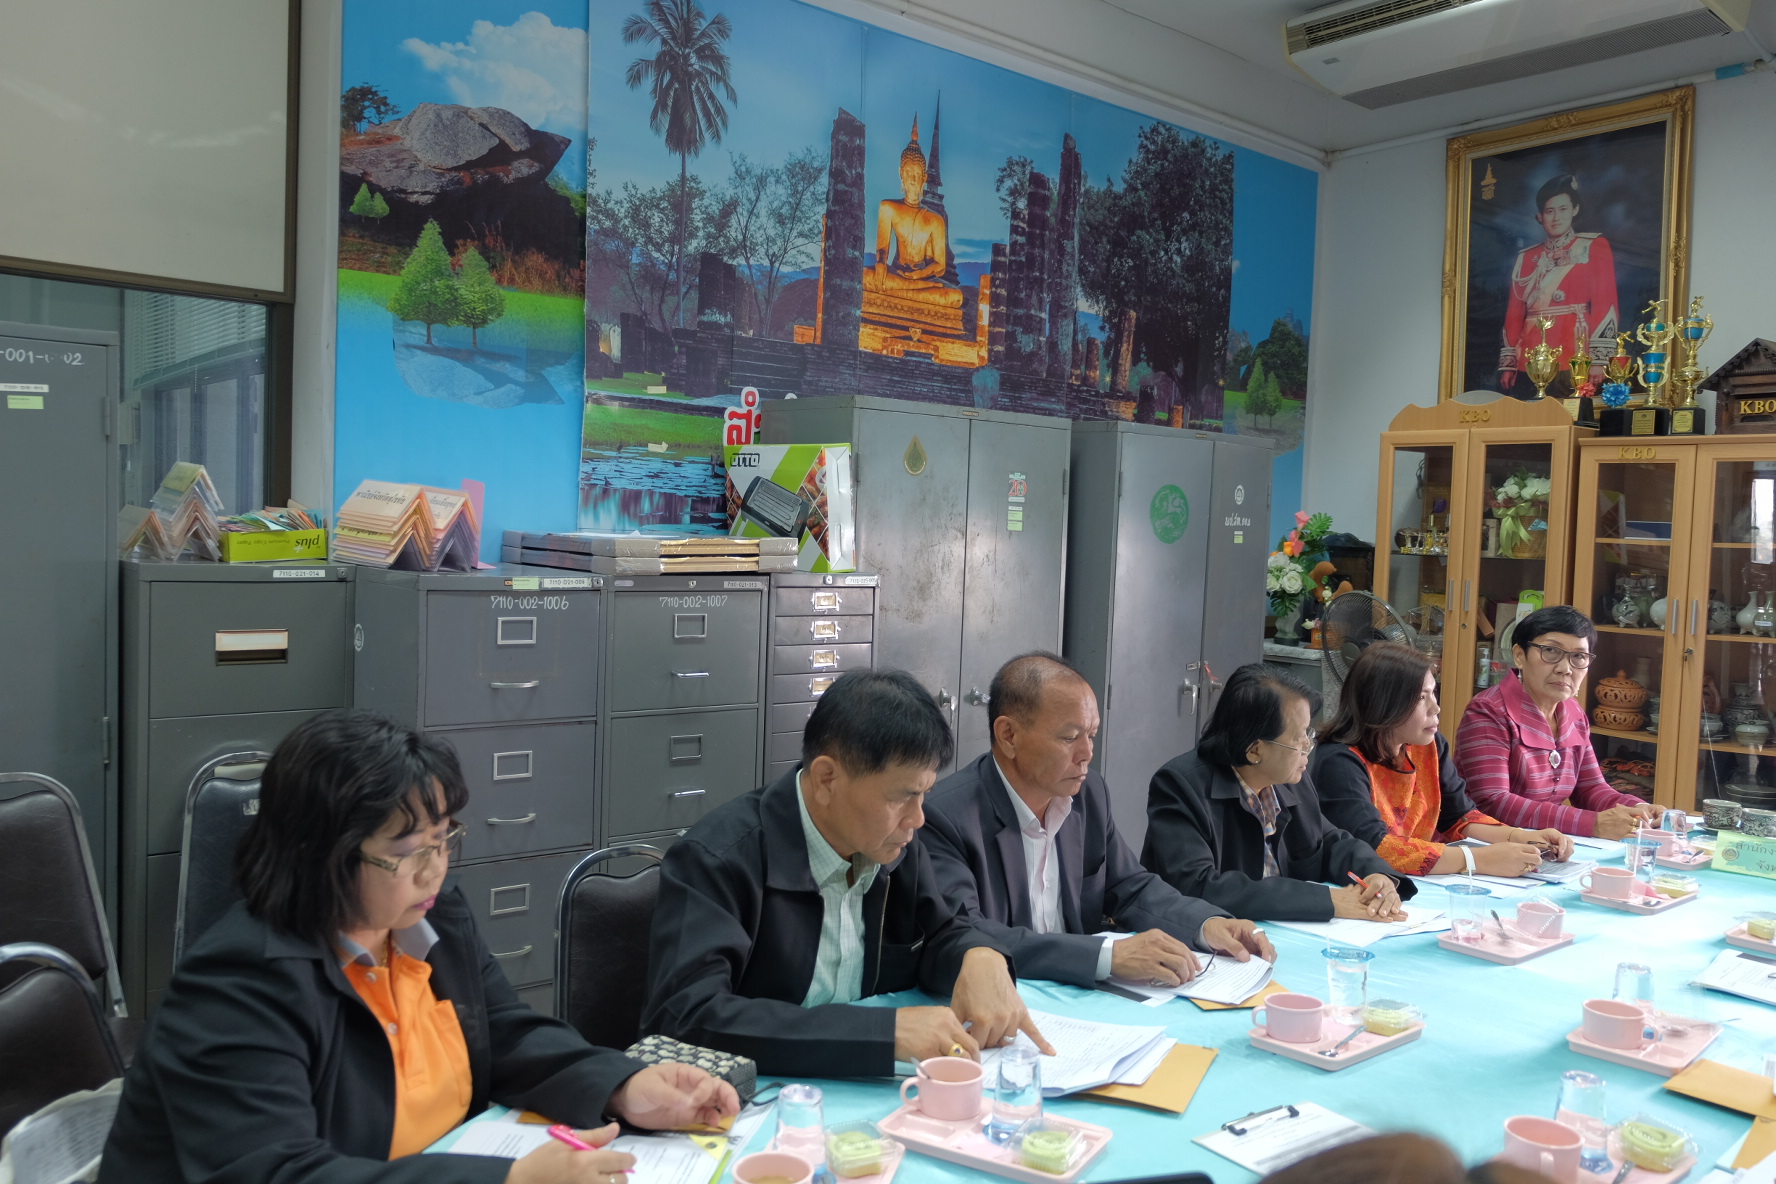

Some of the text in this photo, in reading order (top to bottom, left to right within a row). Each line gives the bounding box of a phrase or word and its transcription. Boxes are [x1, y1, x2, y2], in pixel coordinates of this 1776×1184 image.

[1740, 399, 1776, 414] KBO
[1459, 409, 1491, 424] KBO
[731, 453, 760, 467] OTTO
[1618, 446, 1656, 460] KBO
[295, 534, 320, 549] plus
[491, 596, 569, 610] 7110-002-1006
[660, 595, 728, 608] 7110-002-1007
